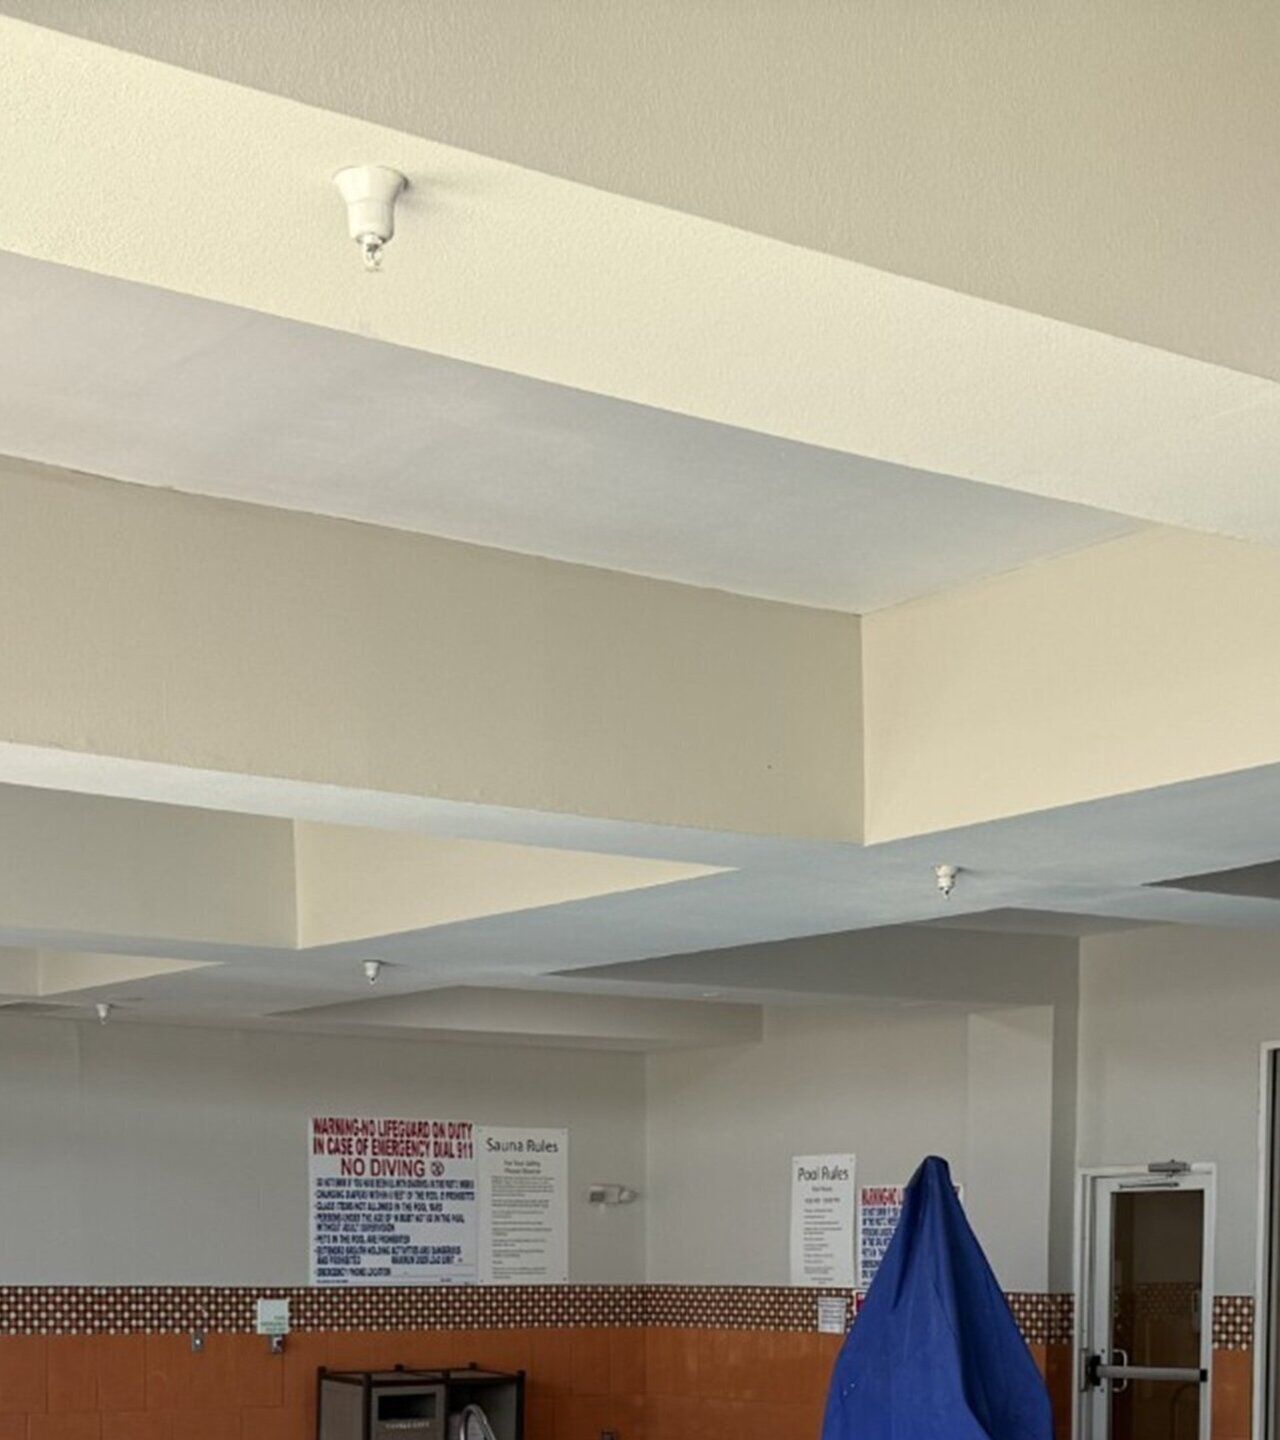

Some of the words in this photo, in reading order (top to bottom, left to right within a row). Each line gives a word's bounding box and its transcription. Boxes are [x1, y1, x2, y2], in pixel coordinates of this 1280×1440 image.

[378, 1119, 429, 1138] LIFEGUARD
[433, 1121, 445, 1138] ON
[448, 1122, 473, 1140] DUTY
[313, 1137, 324, 1155] IN
[327, 1138, 353, 1156] CASE
[356, 1138, 369, 1156] OF
[372, 1139, 430, 1158] EMERGENCY
[433, 1141, 455, 1159] DIAL
[457, 1141, 473, 1159] 911
[486, 1137, 523, 1152] Sauna
[527, 1139, 558, 1153] Rules
[341, 1158, 365, 1176] NO
[371, 1159, 425, 1177] DIVING
[798, 1166, 820, 1182] Pool
[821, 1165, 849, 1181] Rules
